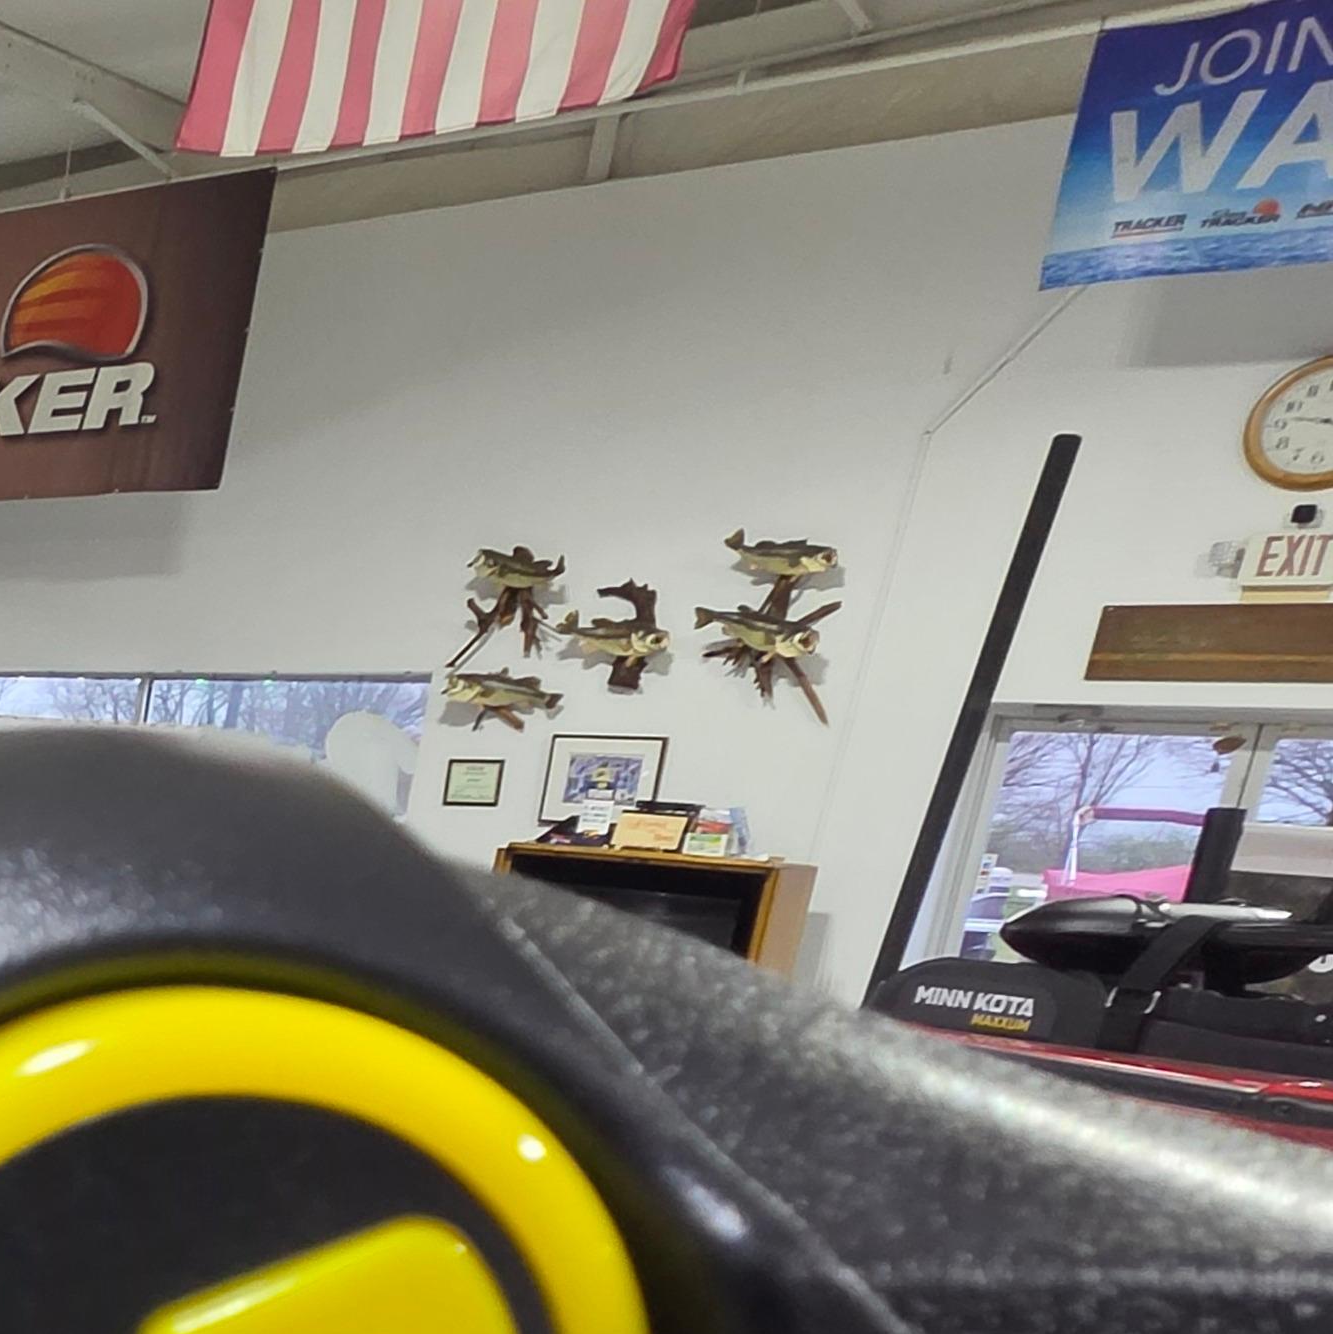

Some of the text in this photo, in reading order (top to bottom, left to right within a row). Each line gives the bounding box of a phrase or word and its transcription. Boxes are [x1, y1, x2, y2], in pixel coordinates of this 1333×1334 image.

[1153, 16, 1333, 96] JOIN
[1113, 213, 1188, 233] TRACKER
[1256, 534, 1333, 577] EXIT
[914, 985, 1034, 1017] MINN KOTA
